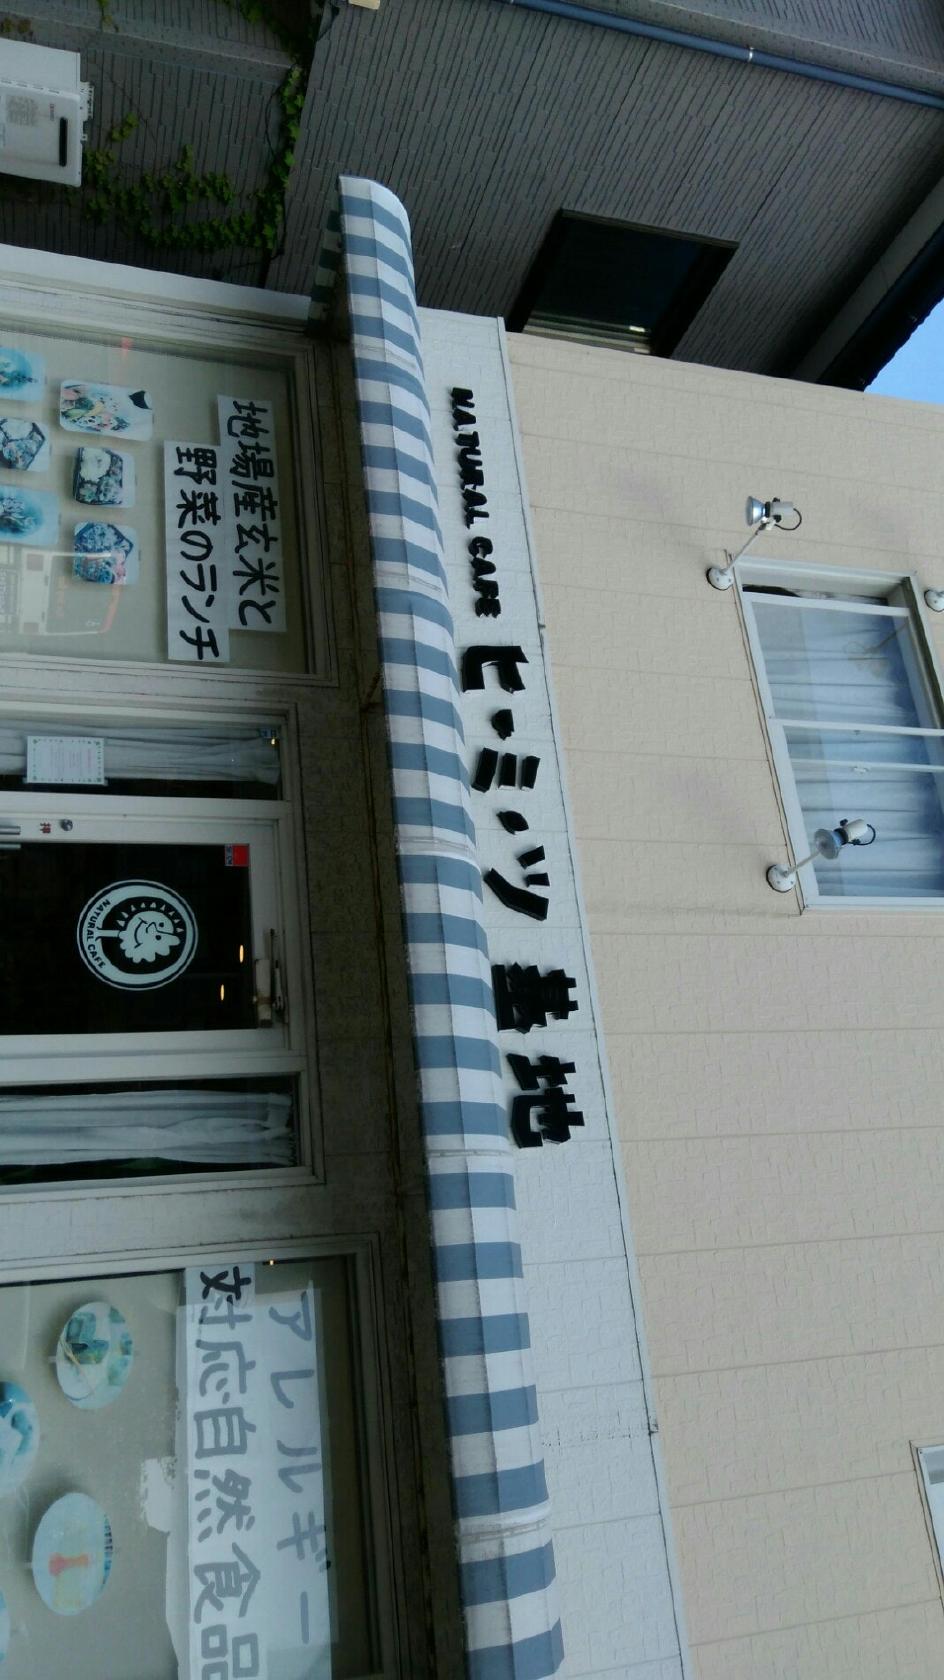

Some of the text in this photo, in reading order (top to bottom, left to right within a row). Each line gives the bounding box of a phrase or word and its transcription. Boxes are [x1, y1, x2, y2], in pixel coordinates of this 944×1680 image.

[174, 446, 221, 660] 野菜のランチ
[227, 401, 280, 627] 地場産玄米と
[451, 387, 501, 619] NATURAL CAFE
[86, 899, 111, 969] NATURAL CAFE
[193, 1266, 261, 1680] 対応自然食品
[268, 1291, 332, 1645] アレルギー
